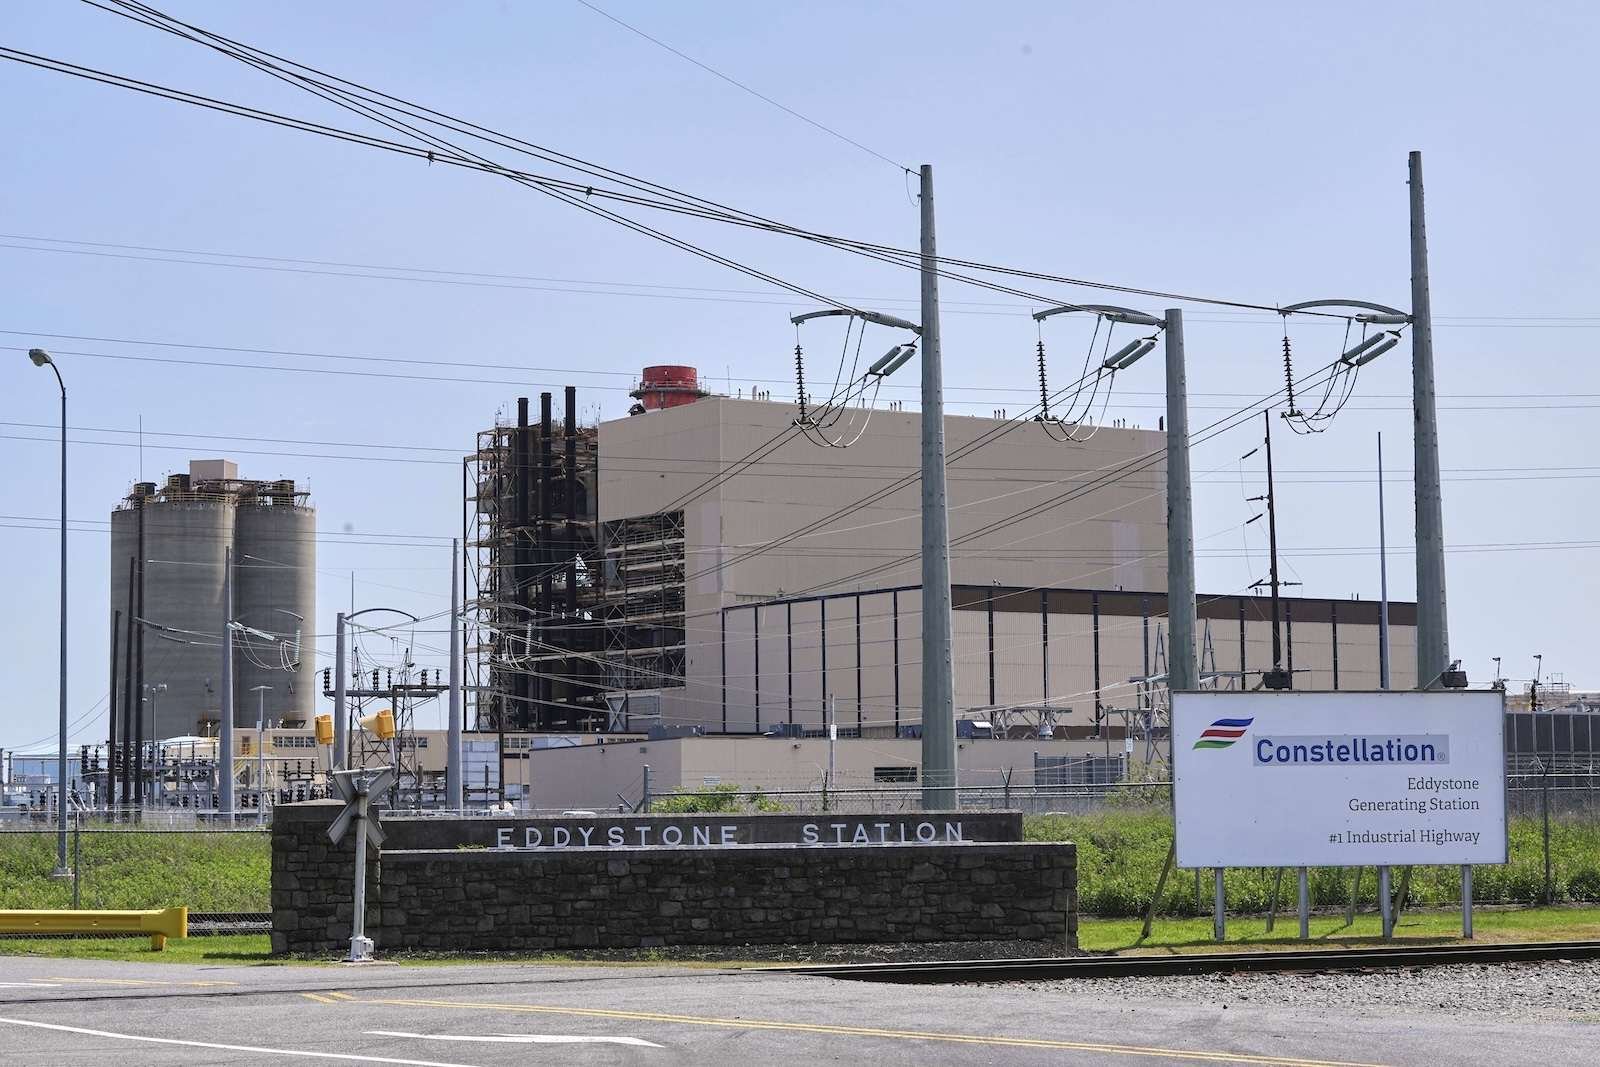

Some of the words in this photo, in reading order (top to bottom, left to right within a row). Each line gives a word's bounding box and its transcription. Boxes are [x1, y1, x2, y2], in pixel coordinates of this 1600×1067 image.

[1407, 776, 1479, 793] Eddystone
[1348, 797, 1427, 814] Generating
[1429, 797, 1480, 811] Station
[496, 825, 738, 849] EDDYSTONE
[802, 822, 963, 844] STATION
[1328, 833, 1344, 845] #1
[1346, 828, 1416, 844] Industrial
[1419, 828, 1481, 846] Highway
